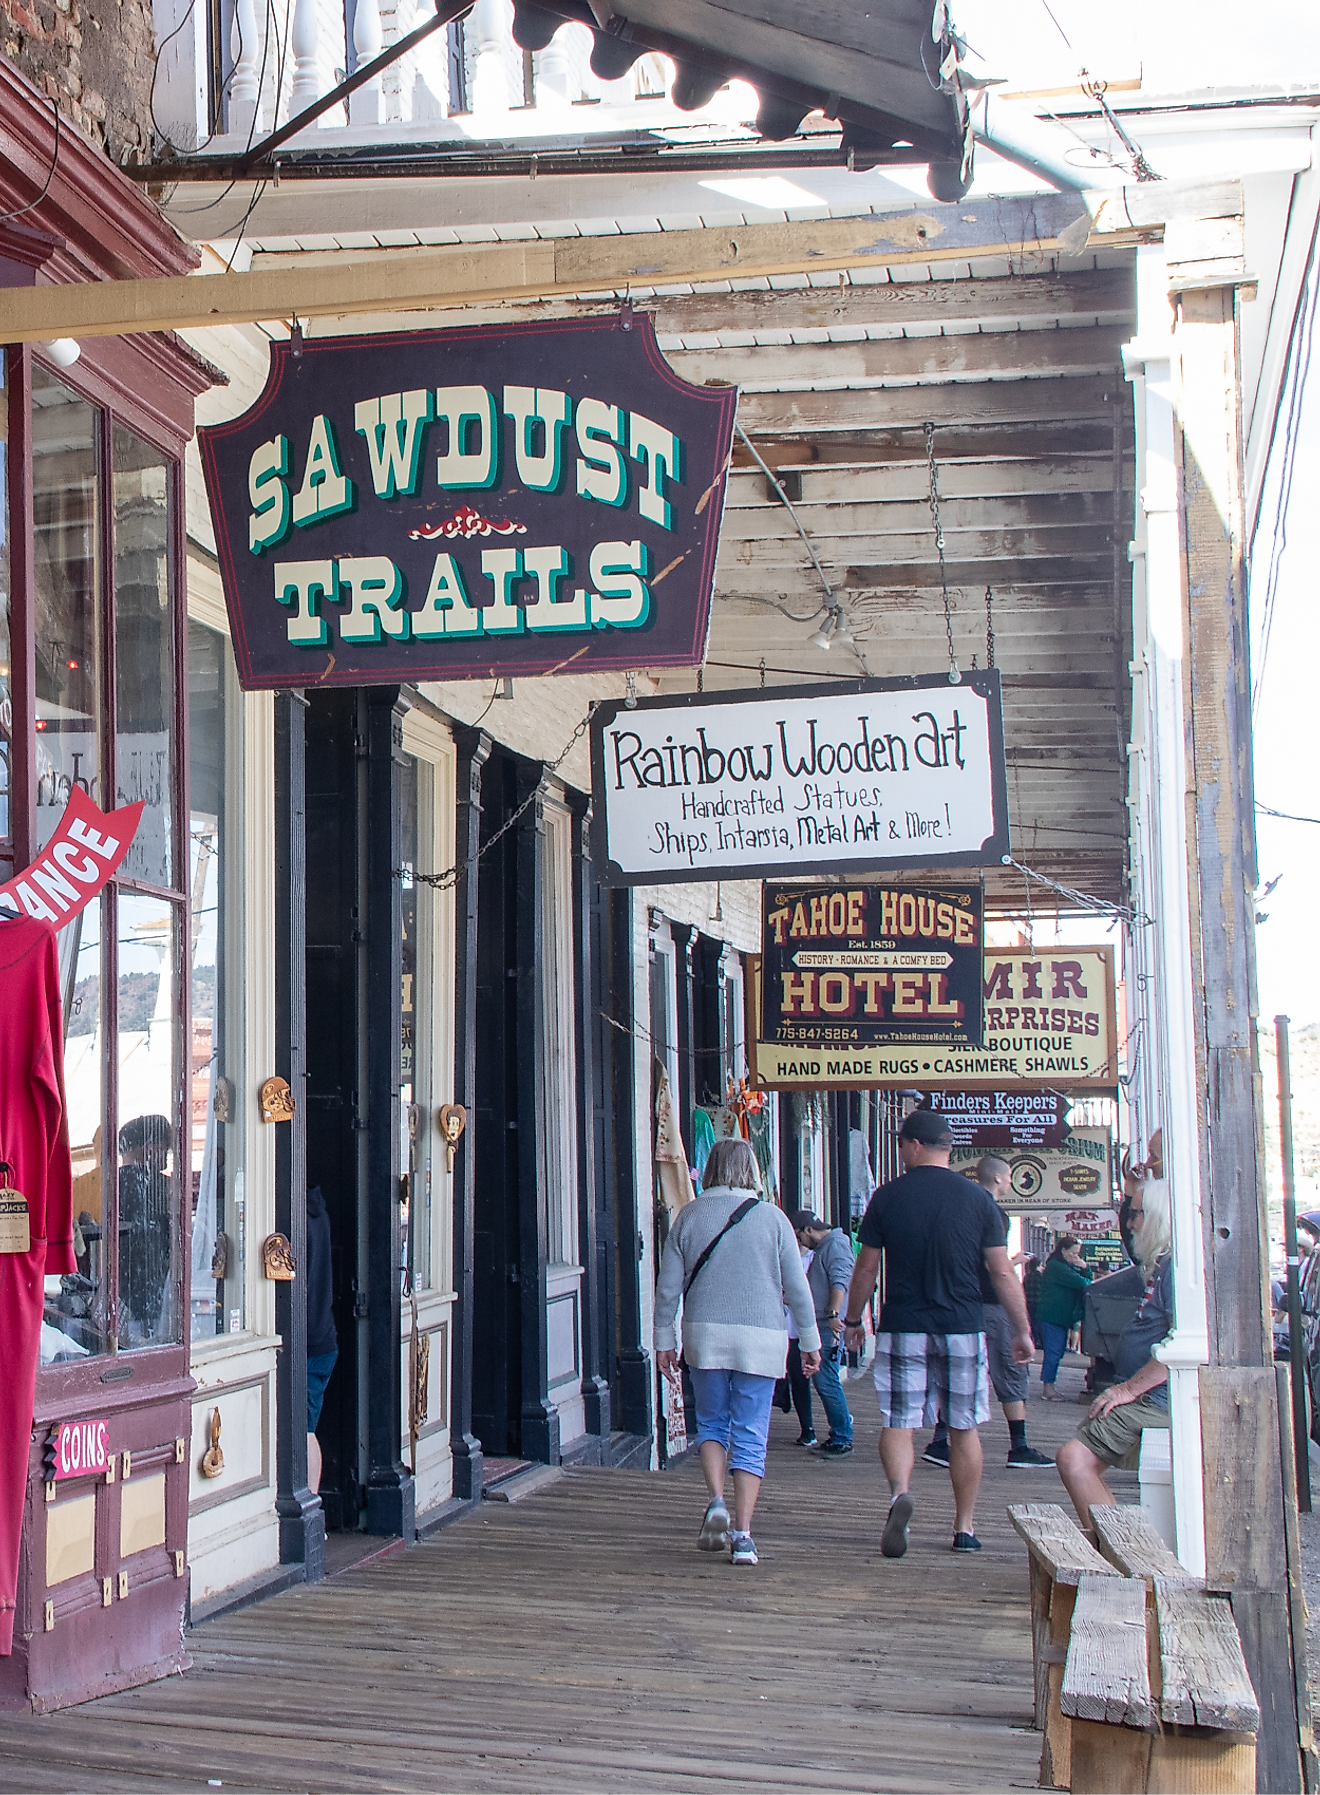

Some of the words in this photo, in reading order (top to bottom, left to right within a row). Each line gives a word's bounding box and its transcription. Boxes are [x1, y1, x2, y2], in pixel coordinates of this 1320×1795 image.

[248, 385, 680, 556] SAWDUST
[274, 540, 648, 647] TRAILS
[610, 728, 773, 790] Rainbow
[776, 715, 907, 779] Wooden
[682, 785, 784, 820] Handcrafted
[648, 820, 713, 866] Ships,
[716, 818, 794, 850] Intarsia,
[796, 814, 848, 846] Metal
[853, 810, 881, 843] Art
[888, 820, 897, 839] &
[768, 891, 867, 947] TAHOE
[880, 891, 979, 947] HOUSE
[848, 940, 868, 950] Est.
[870, 940, 896, 950] 1859
[798, 953, 834, 966] HISTORY
[840, 954, 879, 966] ROMANCE
[892, 954, 899, 966] A
[899, 954, 928, 966] COMFY
[930, 955, 947, 967] BED
[780, 972, 966, 1018] HOTEL
[988, 1036, 1073, 1053] BOUTIQUE
[777, 1062, 821, 1076] HAND
[827, 1061, 873, 1075] MADE
[879, 1059, 919, 1074] RUGS
[934, 1058, 1018, 1073] CASHMERE
[1025, 1056, 1089, 1072] SHAWLS
[930, 1092, 991, 1110] Finders
[994, 1092, 1058, 1115] Keepers
[1006, 1115, 1030, 1124] For
[1032, 1115, 1053, 1124] All
[1012, 1137, 1044, 1145] Everyone
[1071, 1219, 1113, 1231] MAKER
[60, 1421, 107, 1474] COINS
